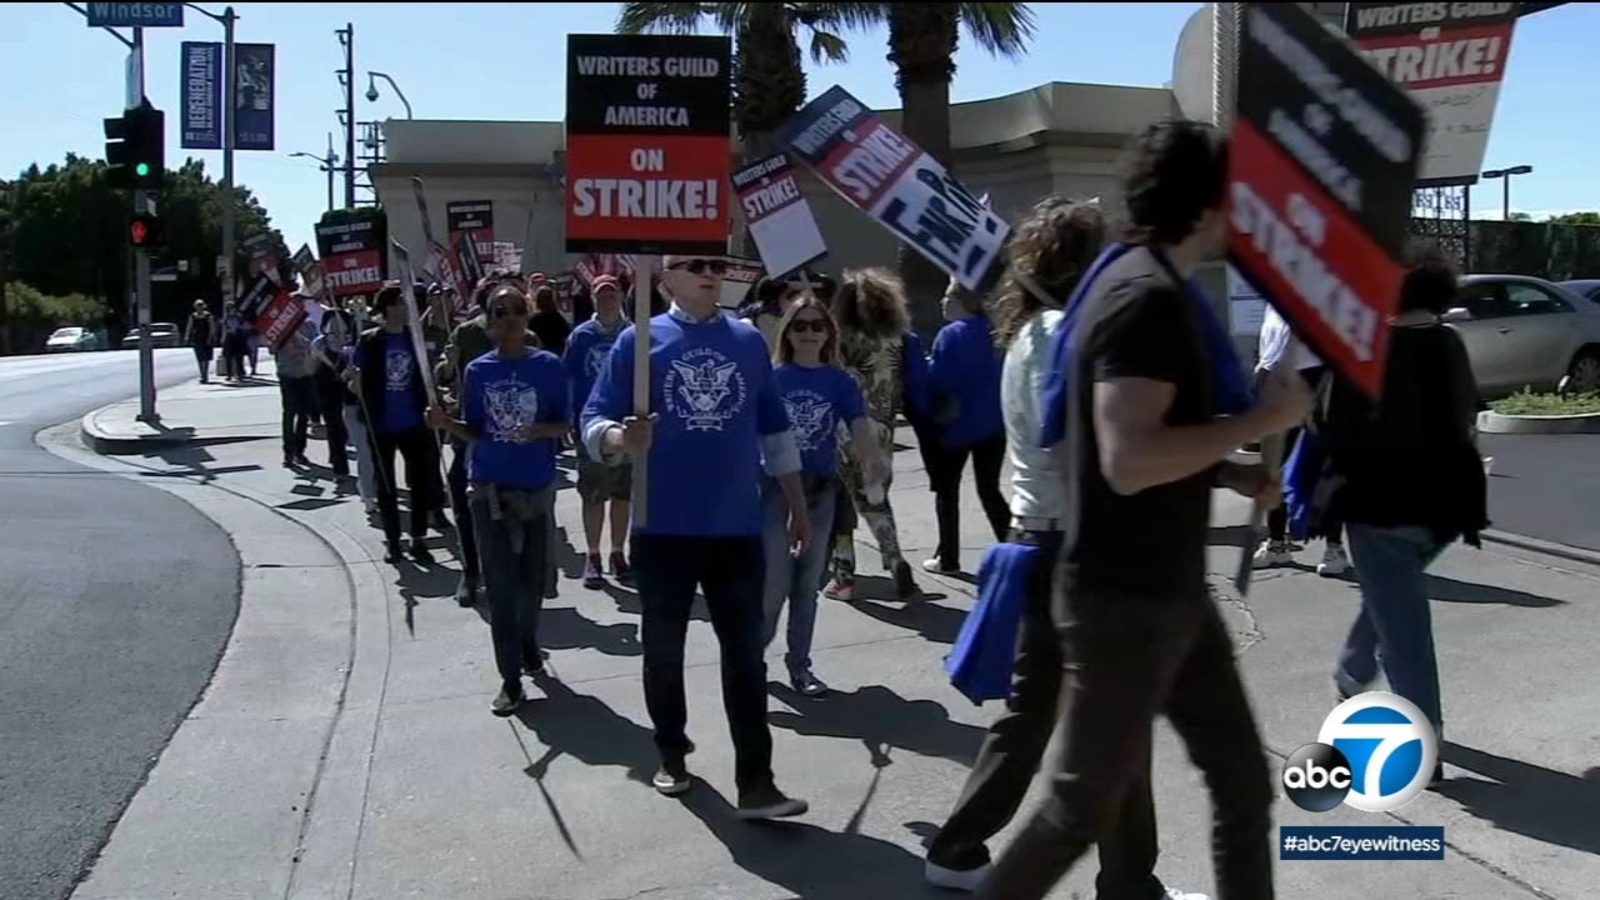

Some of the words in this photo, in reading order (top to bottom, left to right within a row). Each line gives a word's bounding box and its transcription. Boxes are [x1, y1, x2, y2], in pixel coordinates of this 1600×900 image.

[94, 2, 175, 19] Windsor
[1357, 4, 1447, 28] WRITERS
[1451, 2, 1512, 19] GUILD
[576, 56, 661, 76] WRITERS
[664, 57, 720, 77] GUILD
[187, 47, 207, 129] REGENERATION
[637, 83, 659, 100] OF
[604, 105, 690, 127] AMERICA
[790, 111, 842, 155] WRITERS
[630, 148, 664, 172] ON
[832, 123, 914, 200] STRIKE!
[733, 163, 767, 186] WRITERS
[573, 178, 719, 220] STRIKE!
[743, 175, 800, 219] STRIKE!
[325, 266, 381, 289] STRIKE!
